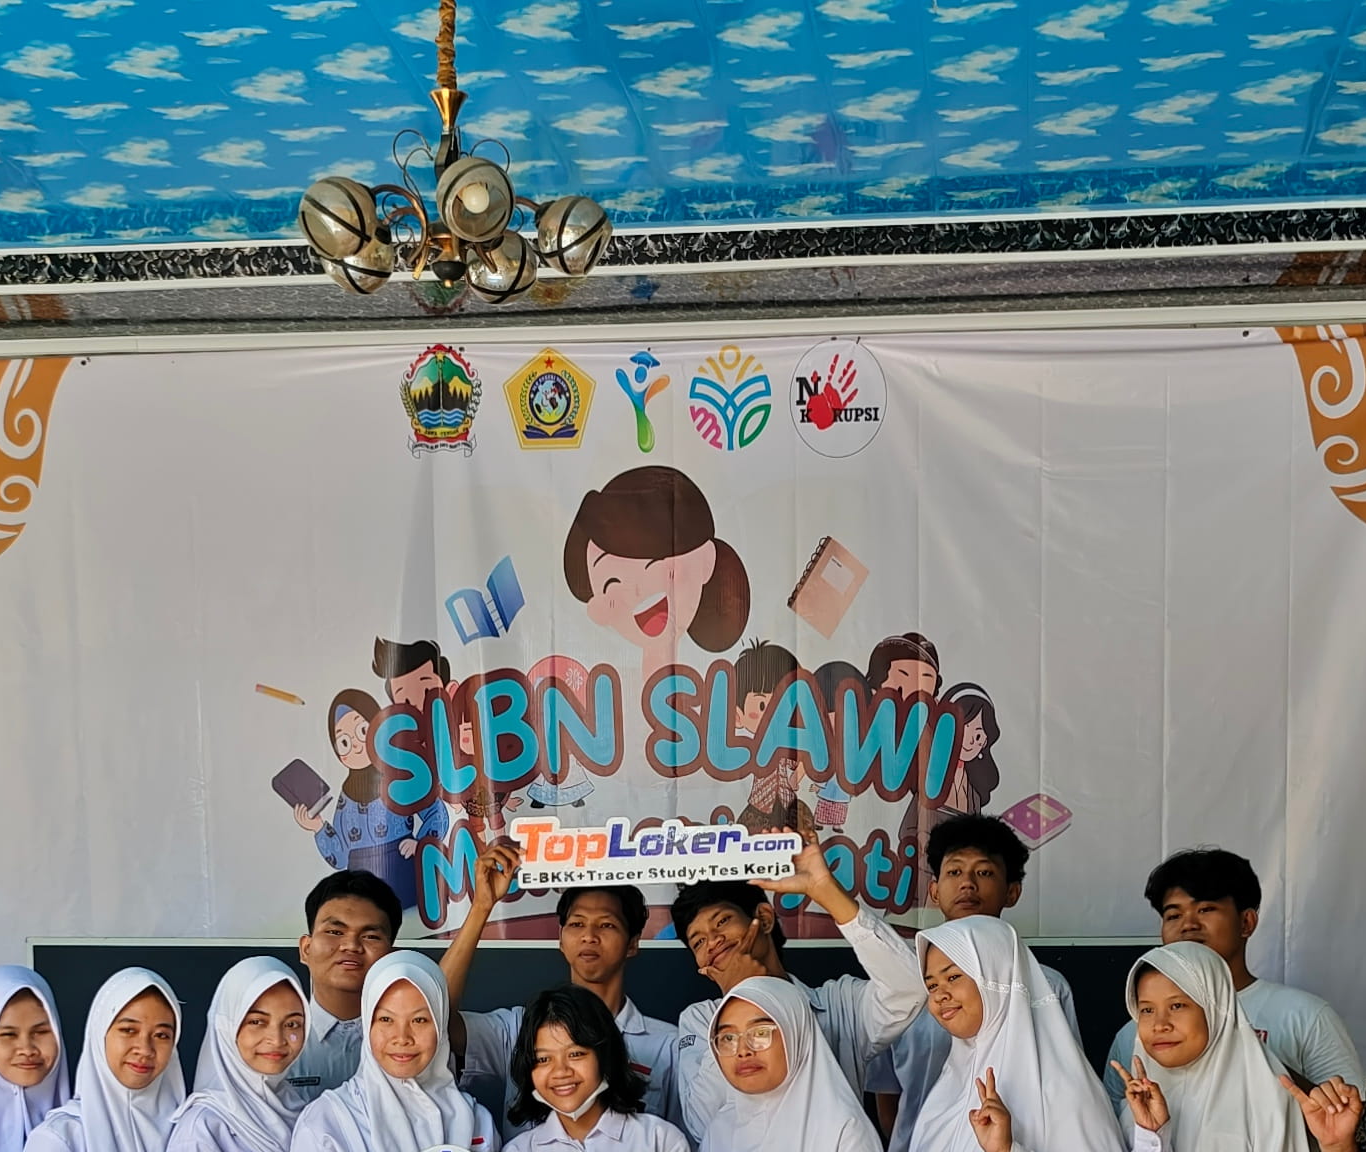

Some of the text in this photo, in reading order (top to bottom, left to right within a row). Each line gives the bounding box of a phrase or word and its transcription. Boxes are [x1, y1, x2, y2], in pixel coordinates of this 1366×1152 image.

[371, 662, 964, 811] SLBN SLAWI
[516, 823, 795, 867] TopLoker.com
[648, 864, 739, 881] Study+Tes
[744, 861, 792, 877] Kerja
